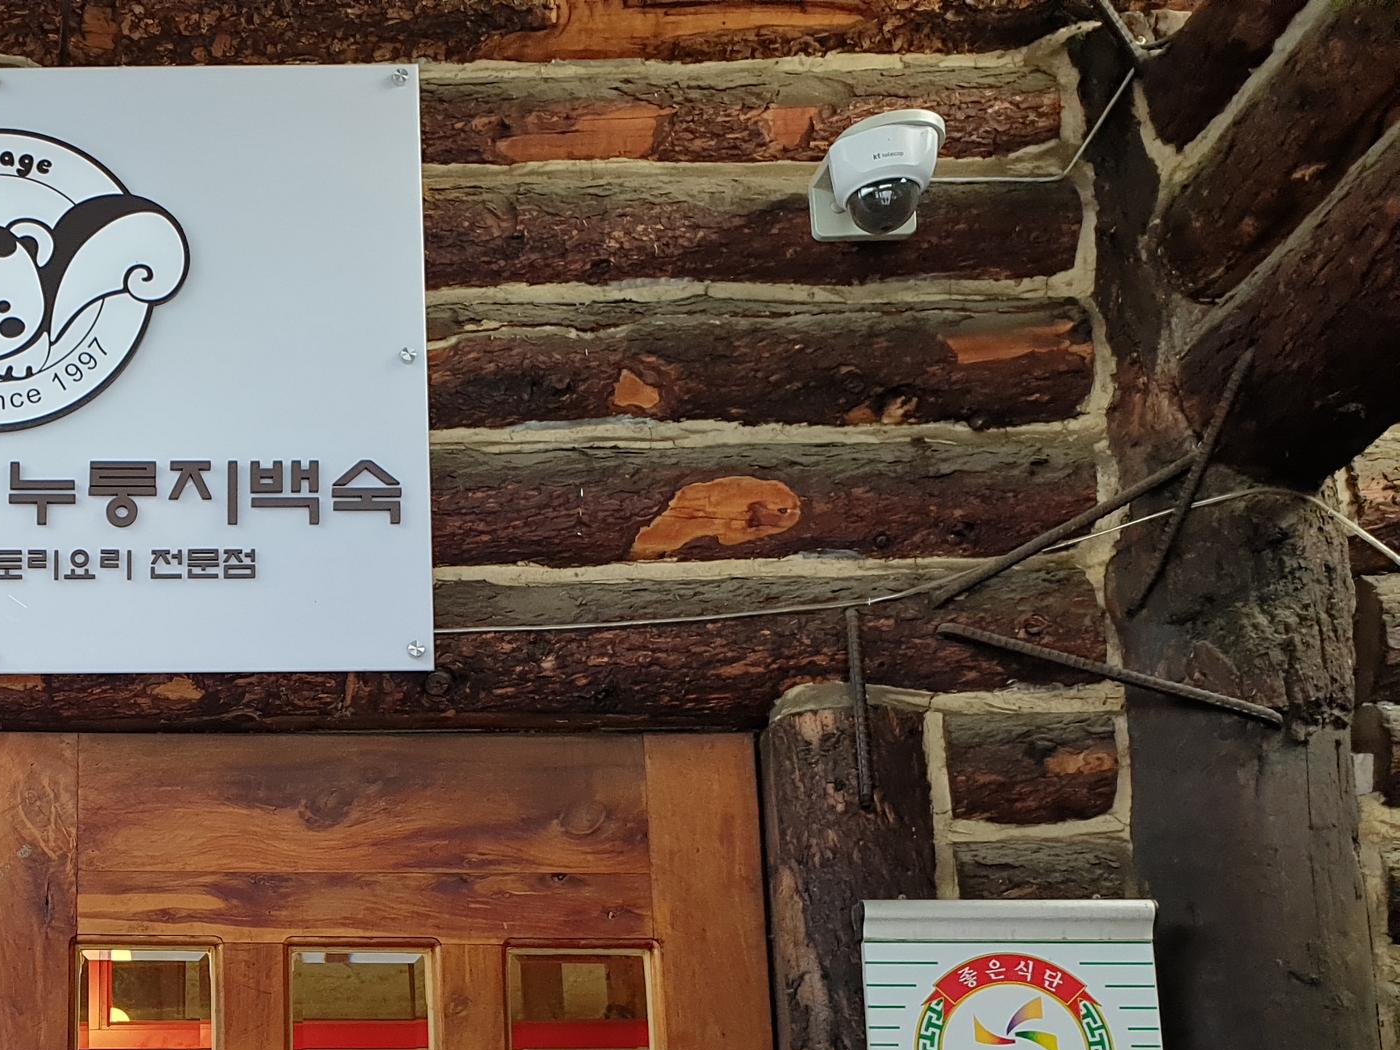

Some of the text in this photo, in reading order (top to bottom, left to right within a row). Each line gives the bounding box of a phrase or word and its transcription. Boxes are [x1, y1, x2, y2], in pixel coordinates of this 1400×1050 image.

[50, 336, 111, 392] 1997
[7, 458, 404, 527] 누룽지백숙
[149, 549, 259, 581] 전문점
